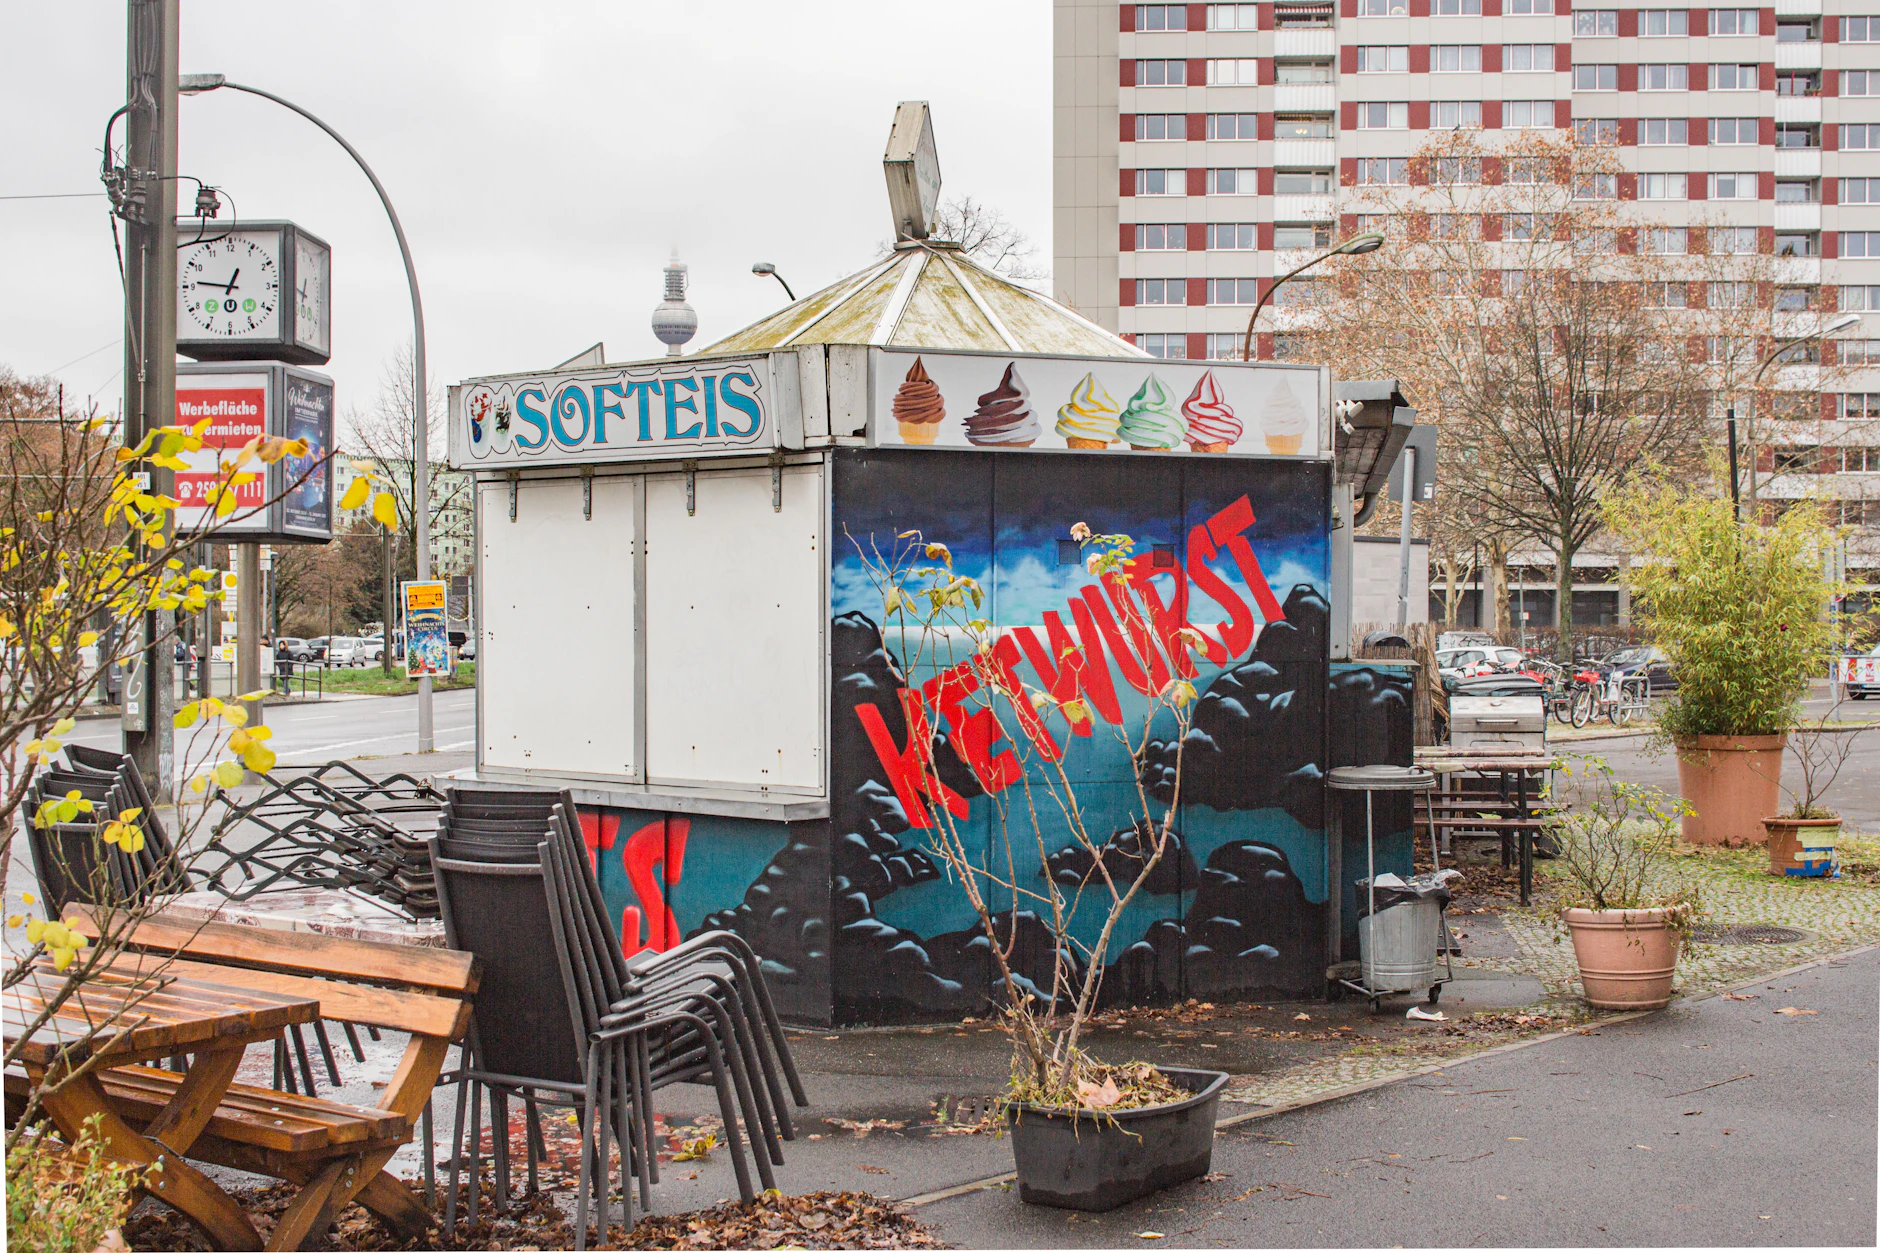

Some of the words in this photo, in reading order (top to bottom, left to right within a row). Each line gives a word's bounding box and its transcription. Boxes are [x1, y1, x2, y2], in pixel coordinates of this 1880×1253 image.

[226, 244, 235, 252] 12
[262, 263, 266, 271] 2
[266, 282, 270, 290] 3
[248, 316, 252, 324] 5
[179, 400, 258, 416] Werbefläche
[515, 372, 761, 449] SOFTEIS
[198, 421, 262, 436] ermieten
[854, 493, 1287, 829] KETWURST
